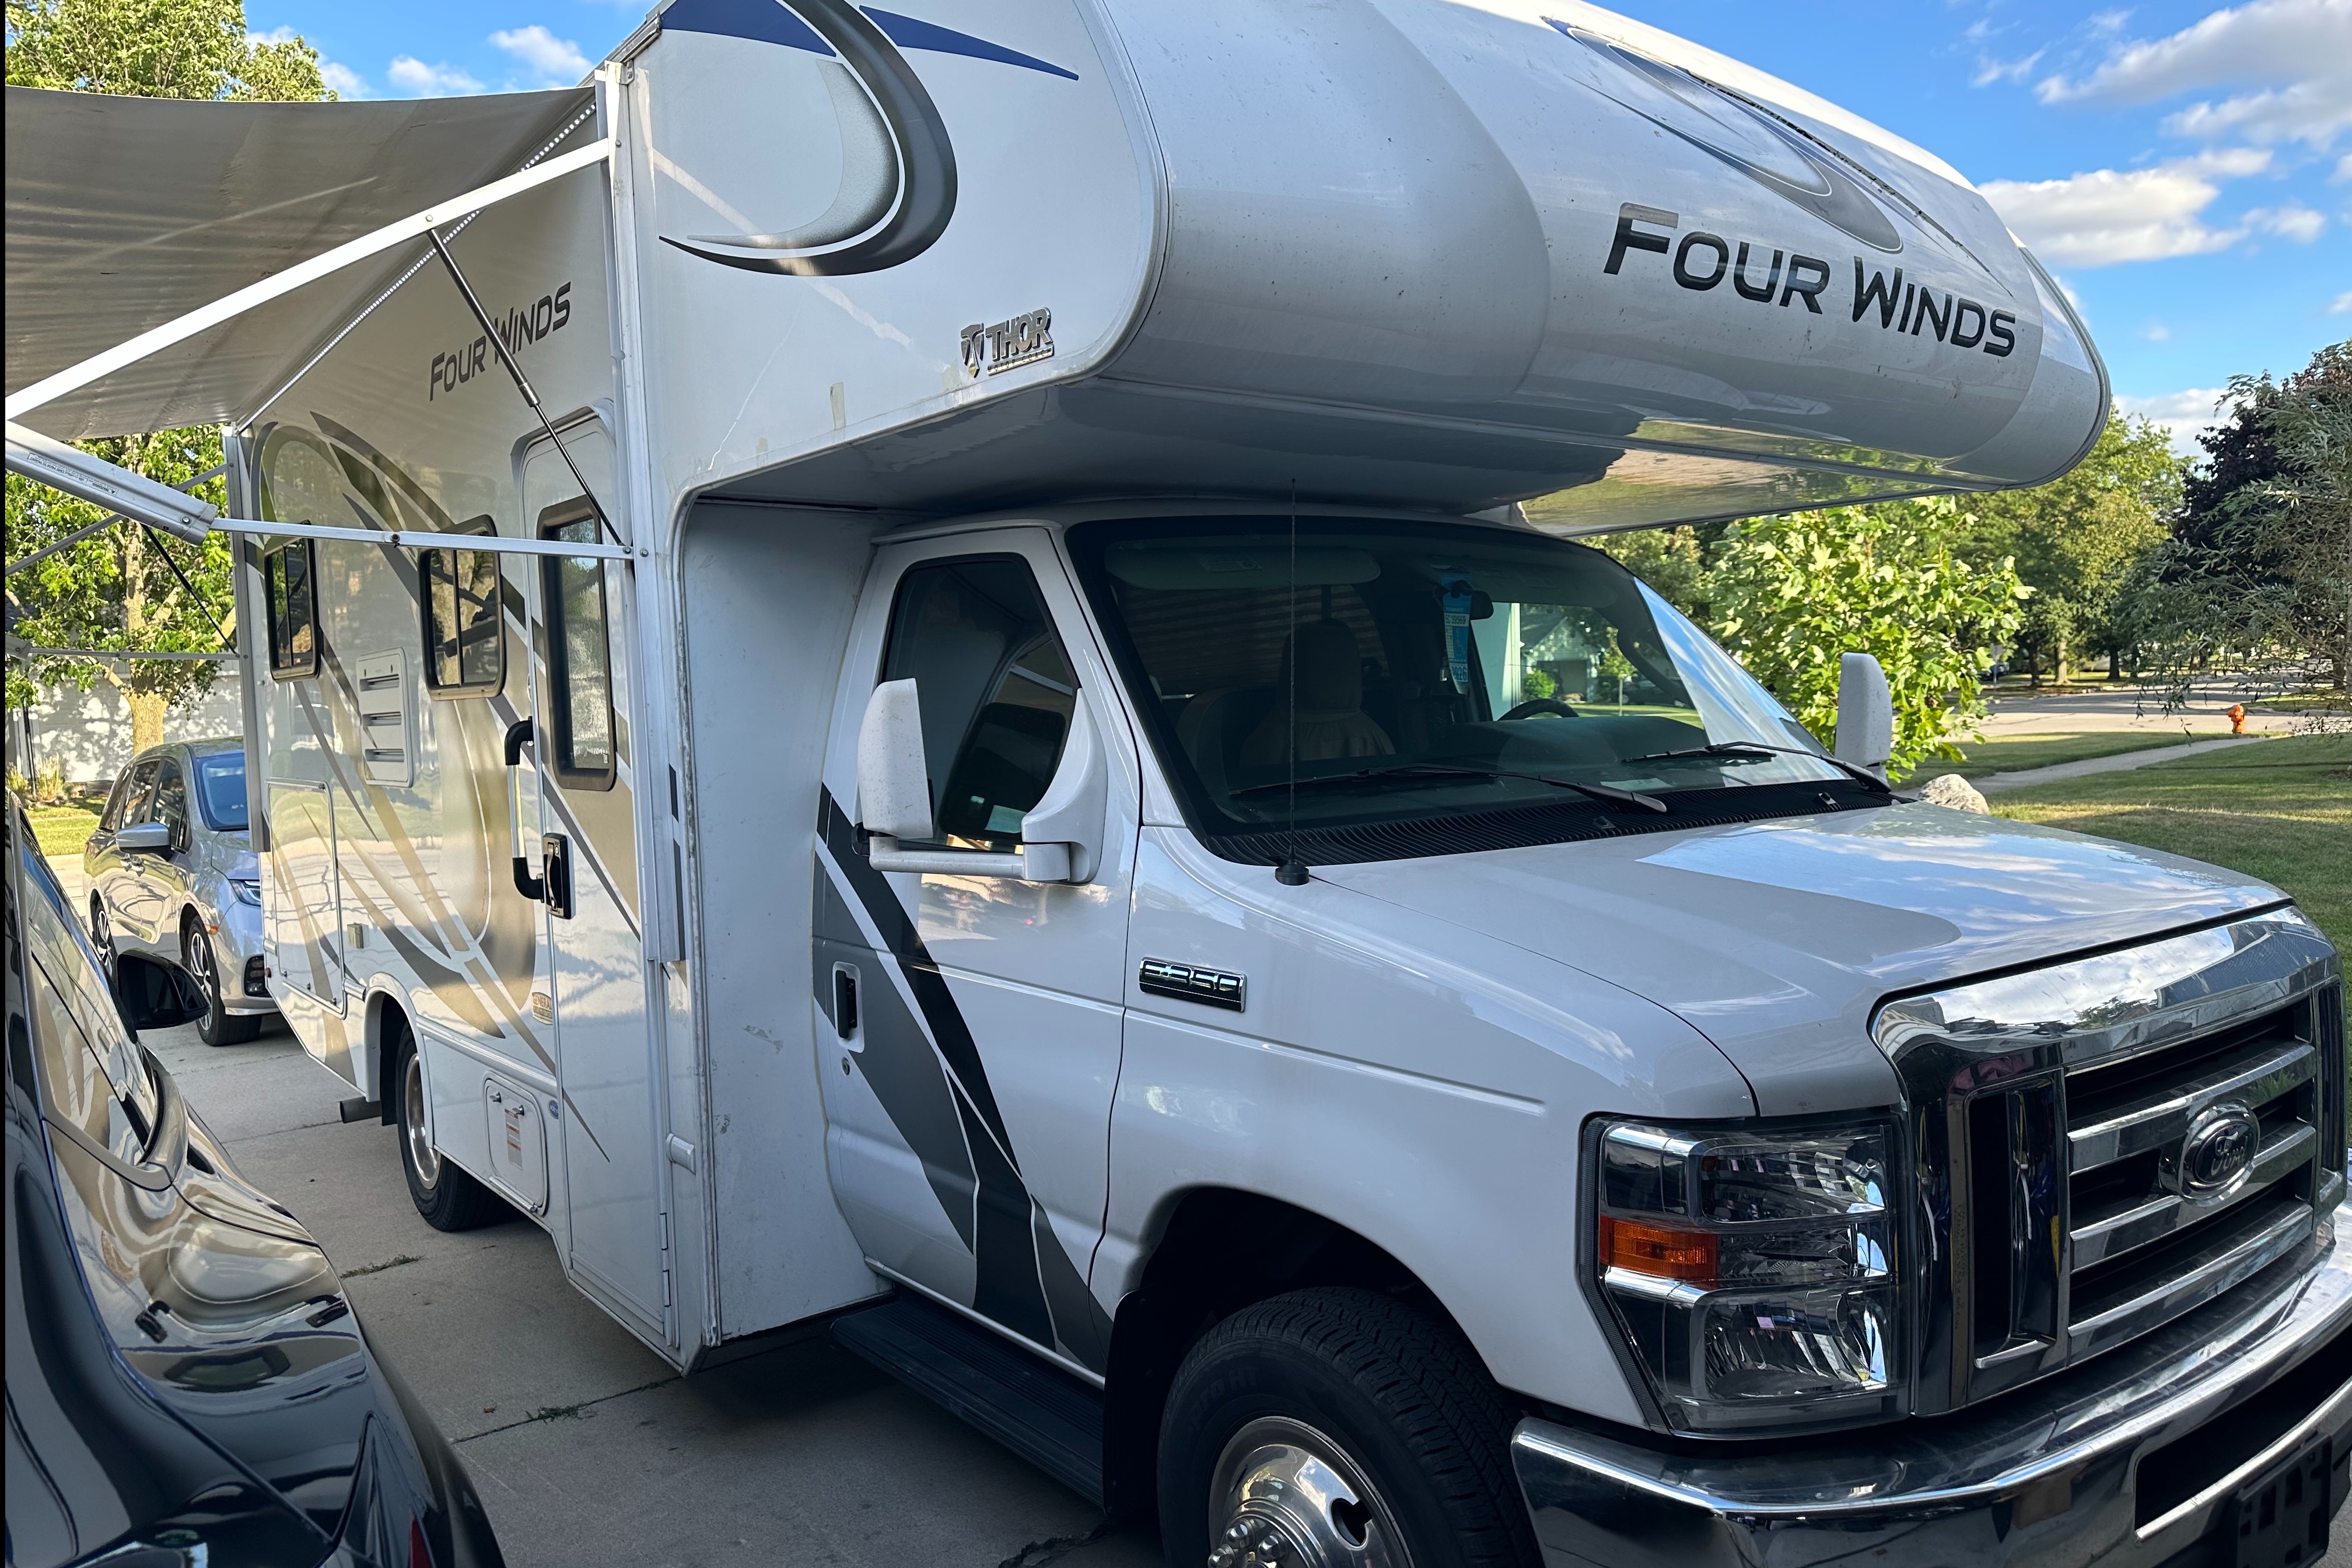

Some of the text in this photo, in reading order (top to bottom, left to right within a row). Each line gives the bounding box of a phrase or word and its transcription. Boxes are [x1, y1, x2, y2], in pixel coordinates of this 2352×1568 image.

[1604, 202, 2016, 357] FOUR WINDS
[985, 307, 1054, 362] THOR
[429, 335, 487, 401] FOUR
[2211, 1130, 2249, 1177] Ford
